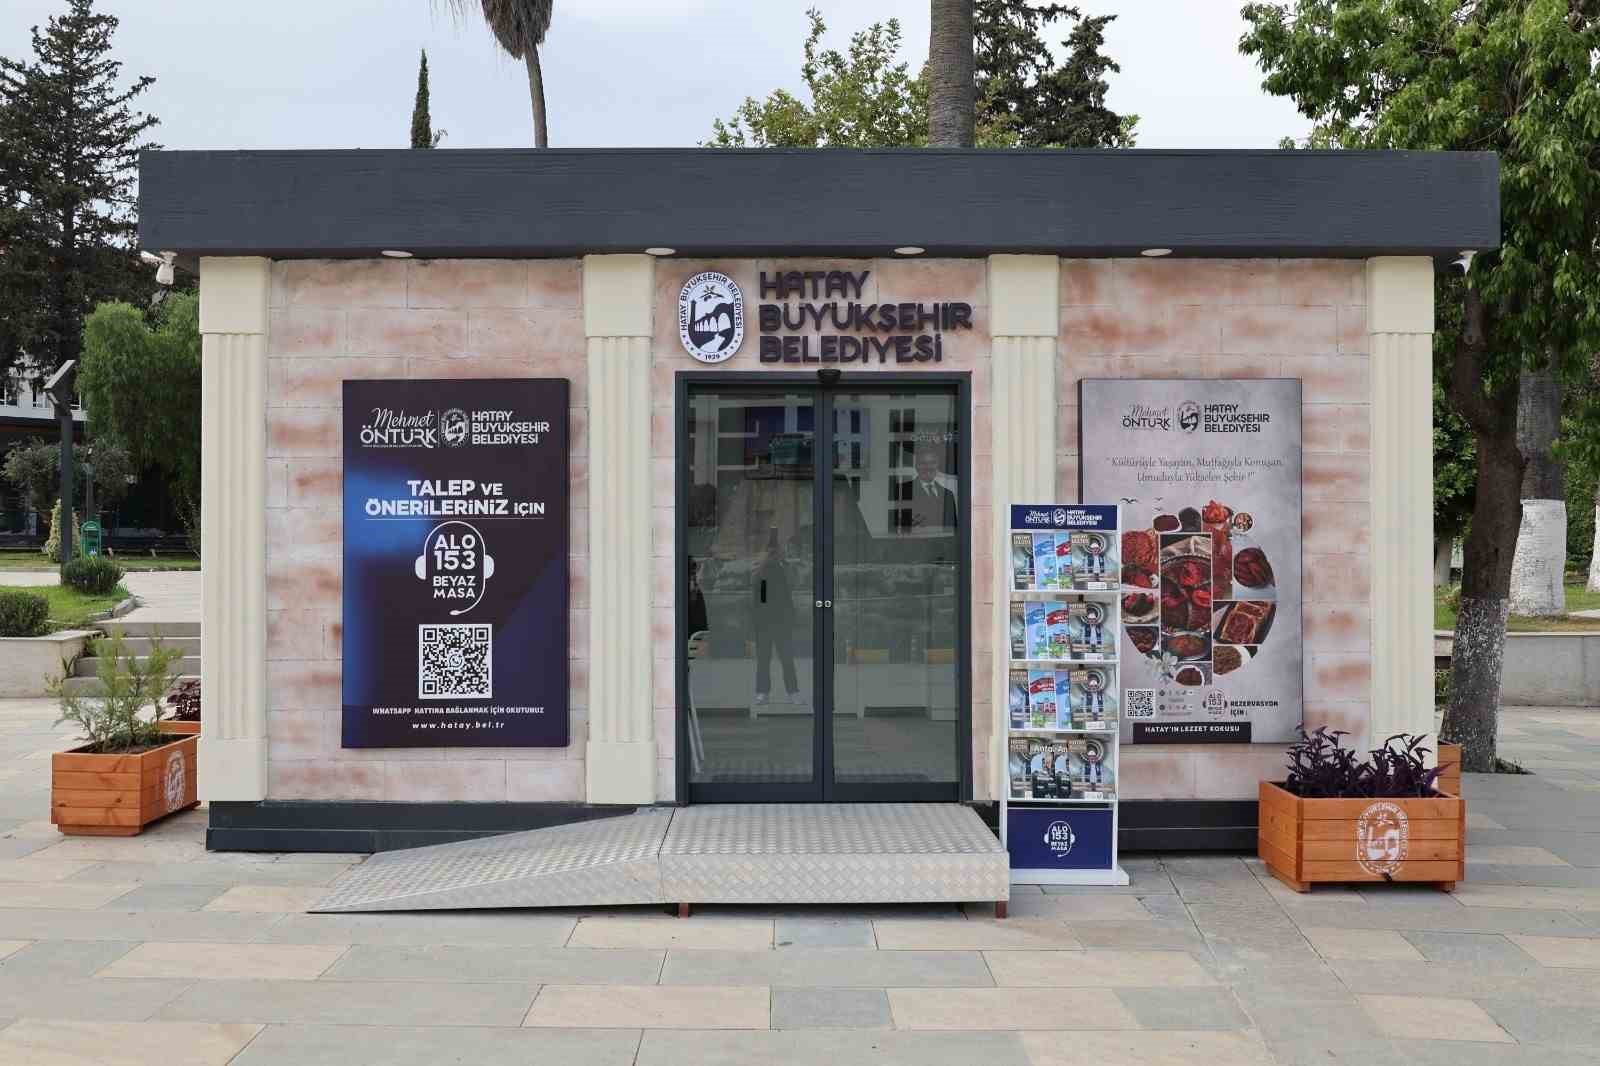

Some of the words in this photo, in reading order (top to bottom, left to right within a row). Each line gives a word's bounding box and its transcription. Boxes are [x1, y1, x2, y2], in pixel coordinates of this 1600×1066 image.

[759, 271, 870, 300] HATAY
[1204, 404, 1239, 413] HATAY
[371, 407, 434, 428] Mehmet
[471, 411, 513, 421] HATAY
[407, 479, 475, 497] TALEP
[481, 483, 503, 496] VE
[365, 498, 508, 516] ÖNERİLERİNİZ
[434, 534, 476, 550] ALO
[434, 550, 476, 570] 153
[432, 575, 476, 587] BEYAZ
[433, 588, 476, 599] MASA
[372, 707, 412, 715] WHATSAPP
[412, 721, 505, 730] www.hatay.bel.tr
[1051, 832, 1068, 840] 153
